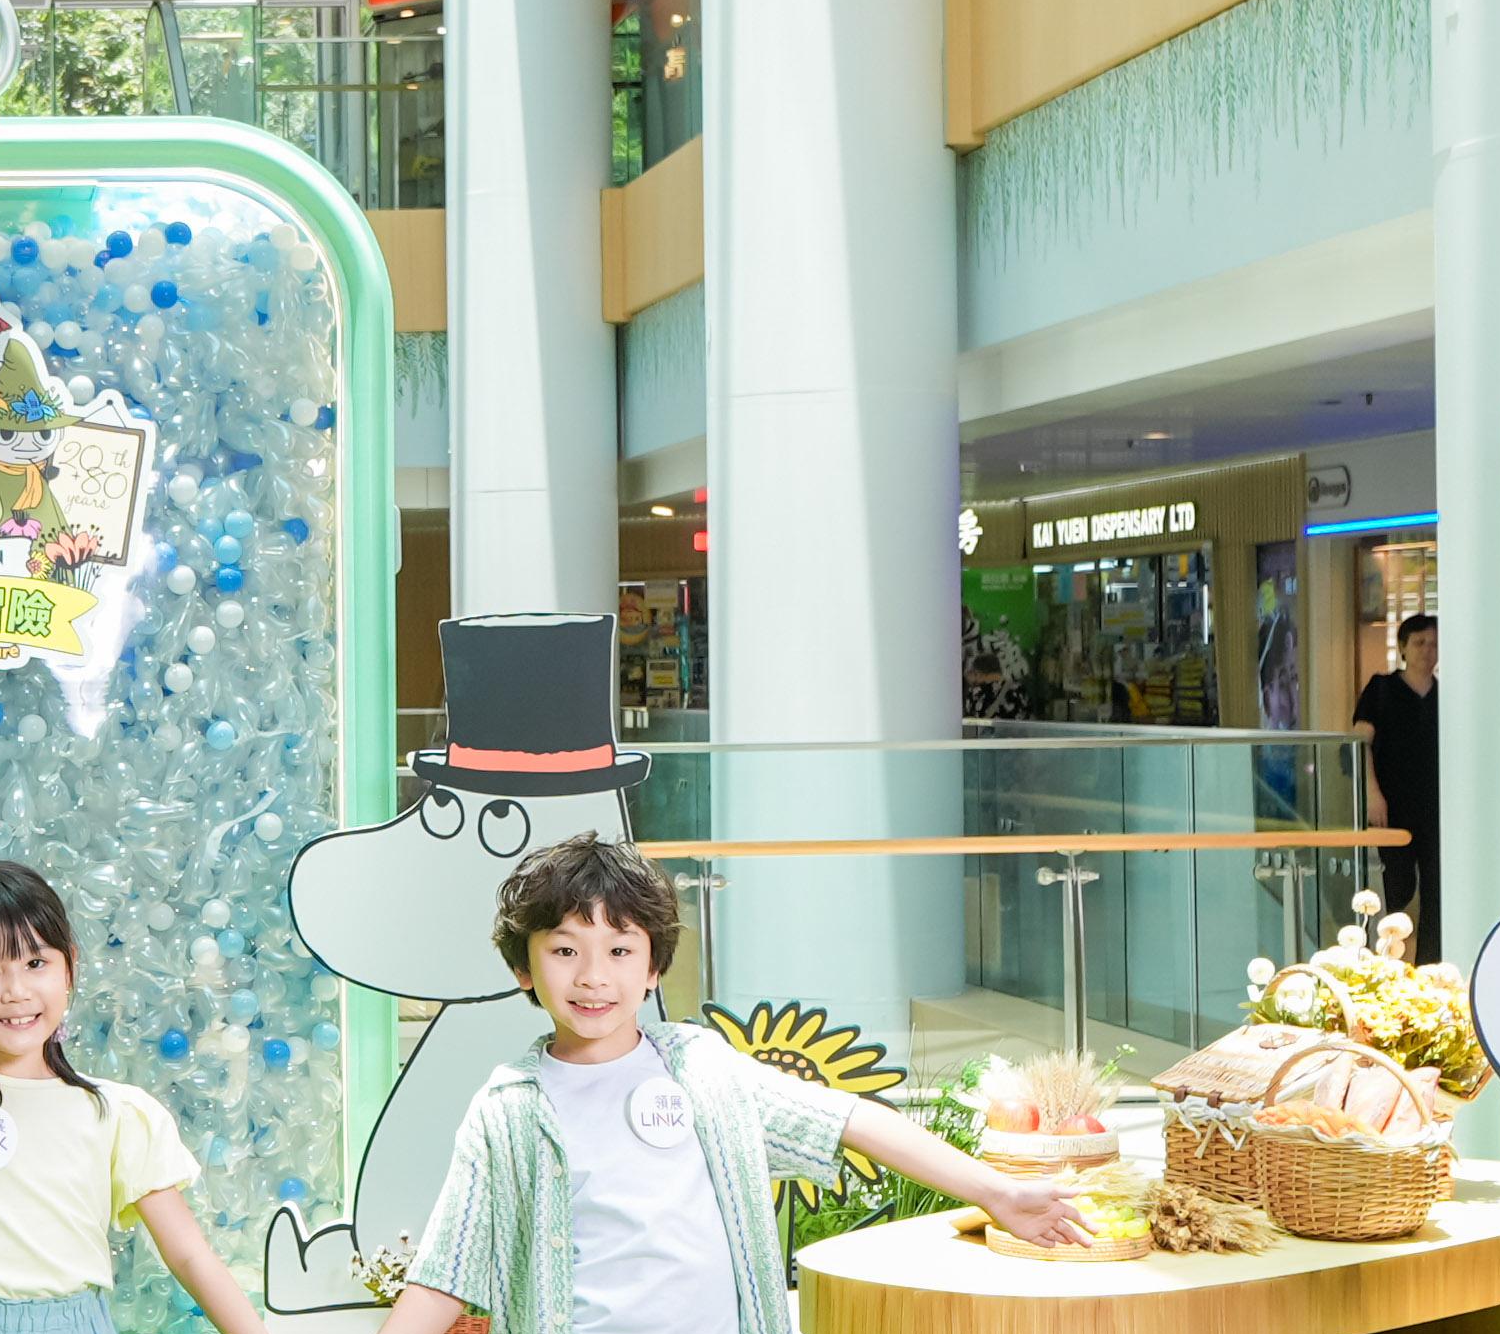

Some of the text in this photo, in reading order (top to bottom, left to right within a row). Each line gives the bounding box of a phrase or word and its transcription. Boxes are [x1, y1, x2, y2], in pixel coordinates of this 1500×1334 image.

[64, 493, 111, 514] years
[1032, 501, 1196, 549] KAI YUEN DISPENSARY LTD
[640, 1112, 686, 1128] LINK
